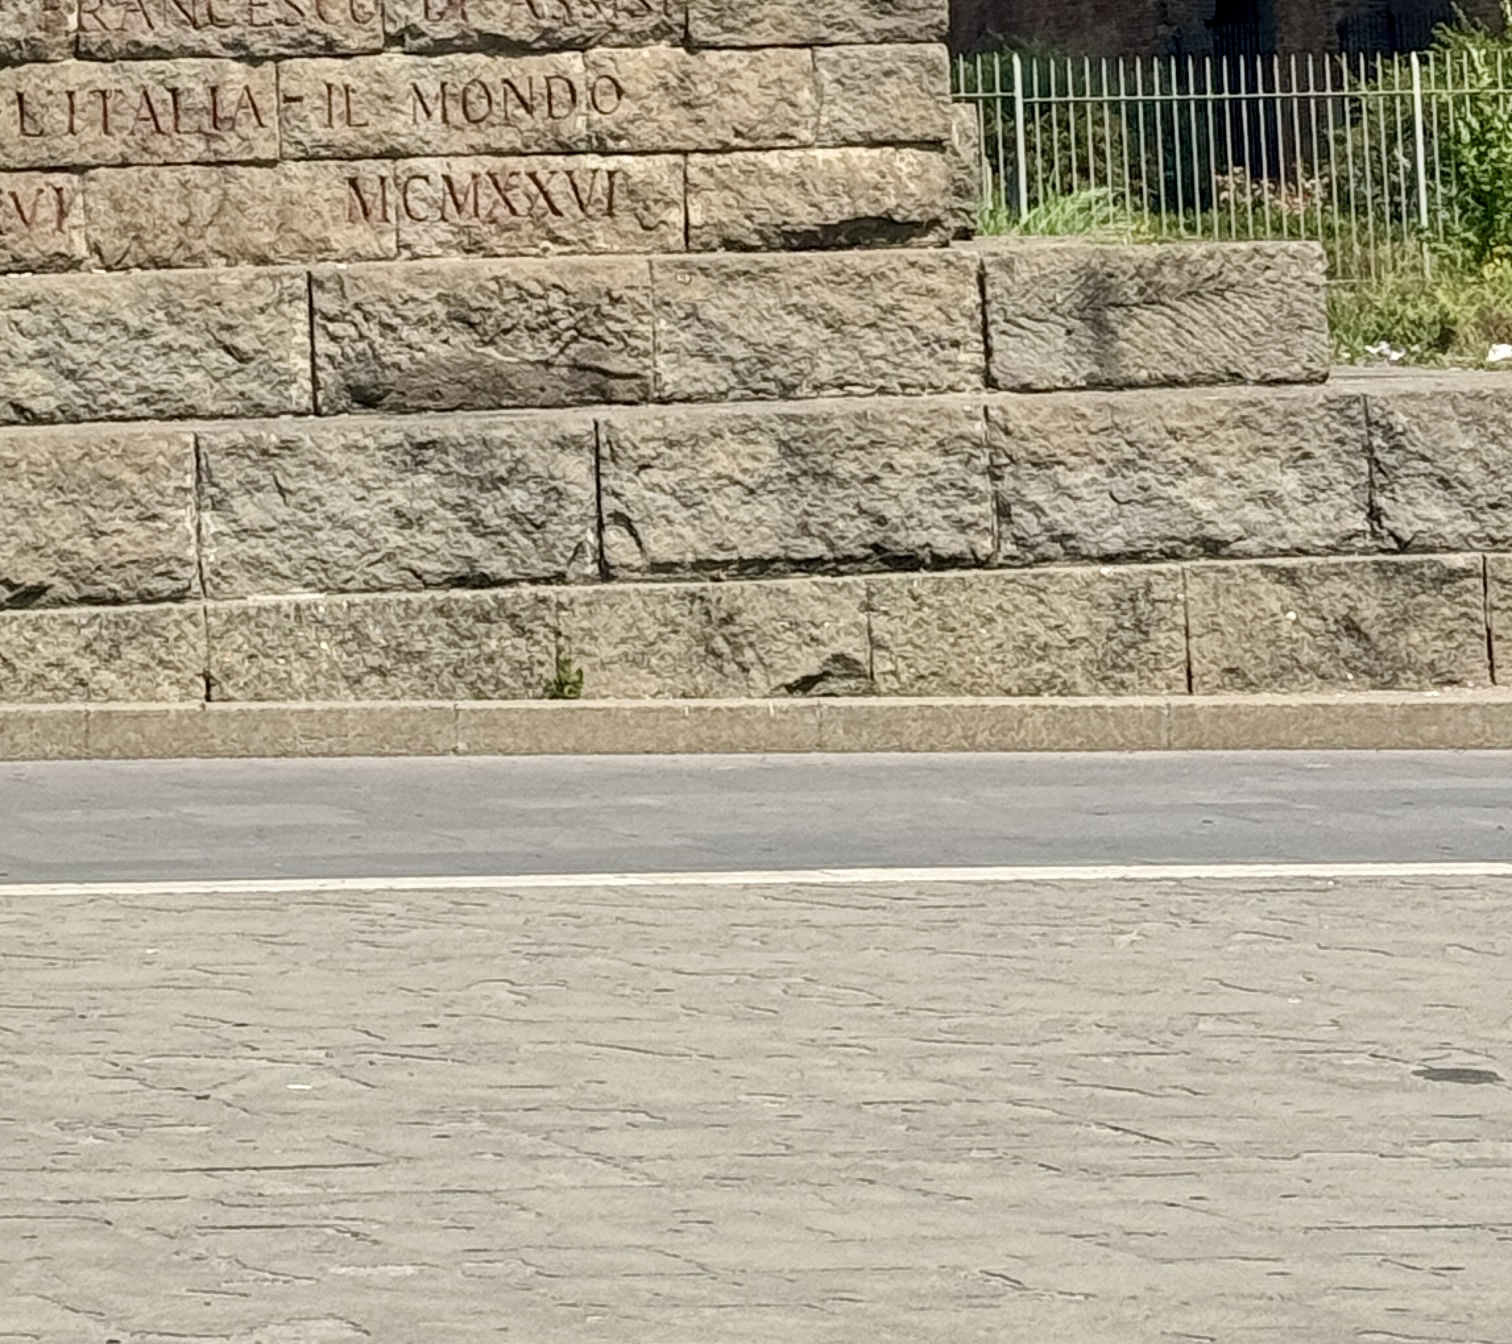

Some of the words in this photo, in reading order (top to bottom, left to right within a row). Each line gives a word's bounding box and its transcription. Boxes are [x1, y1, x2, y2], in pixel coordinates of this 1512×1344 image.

[324, 80, 370, 129] IL
[411, 74, 625, 127] MONDO
[345, 169, 619, 224] MCMXXVI
